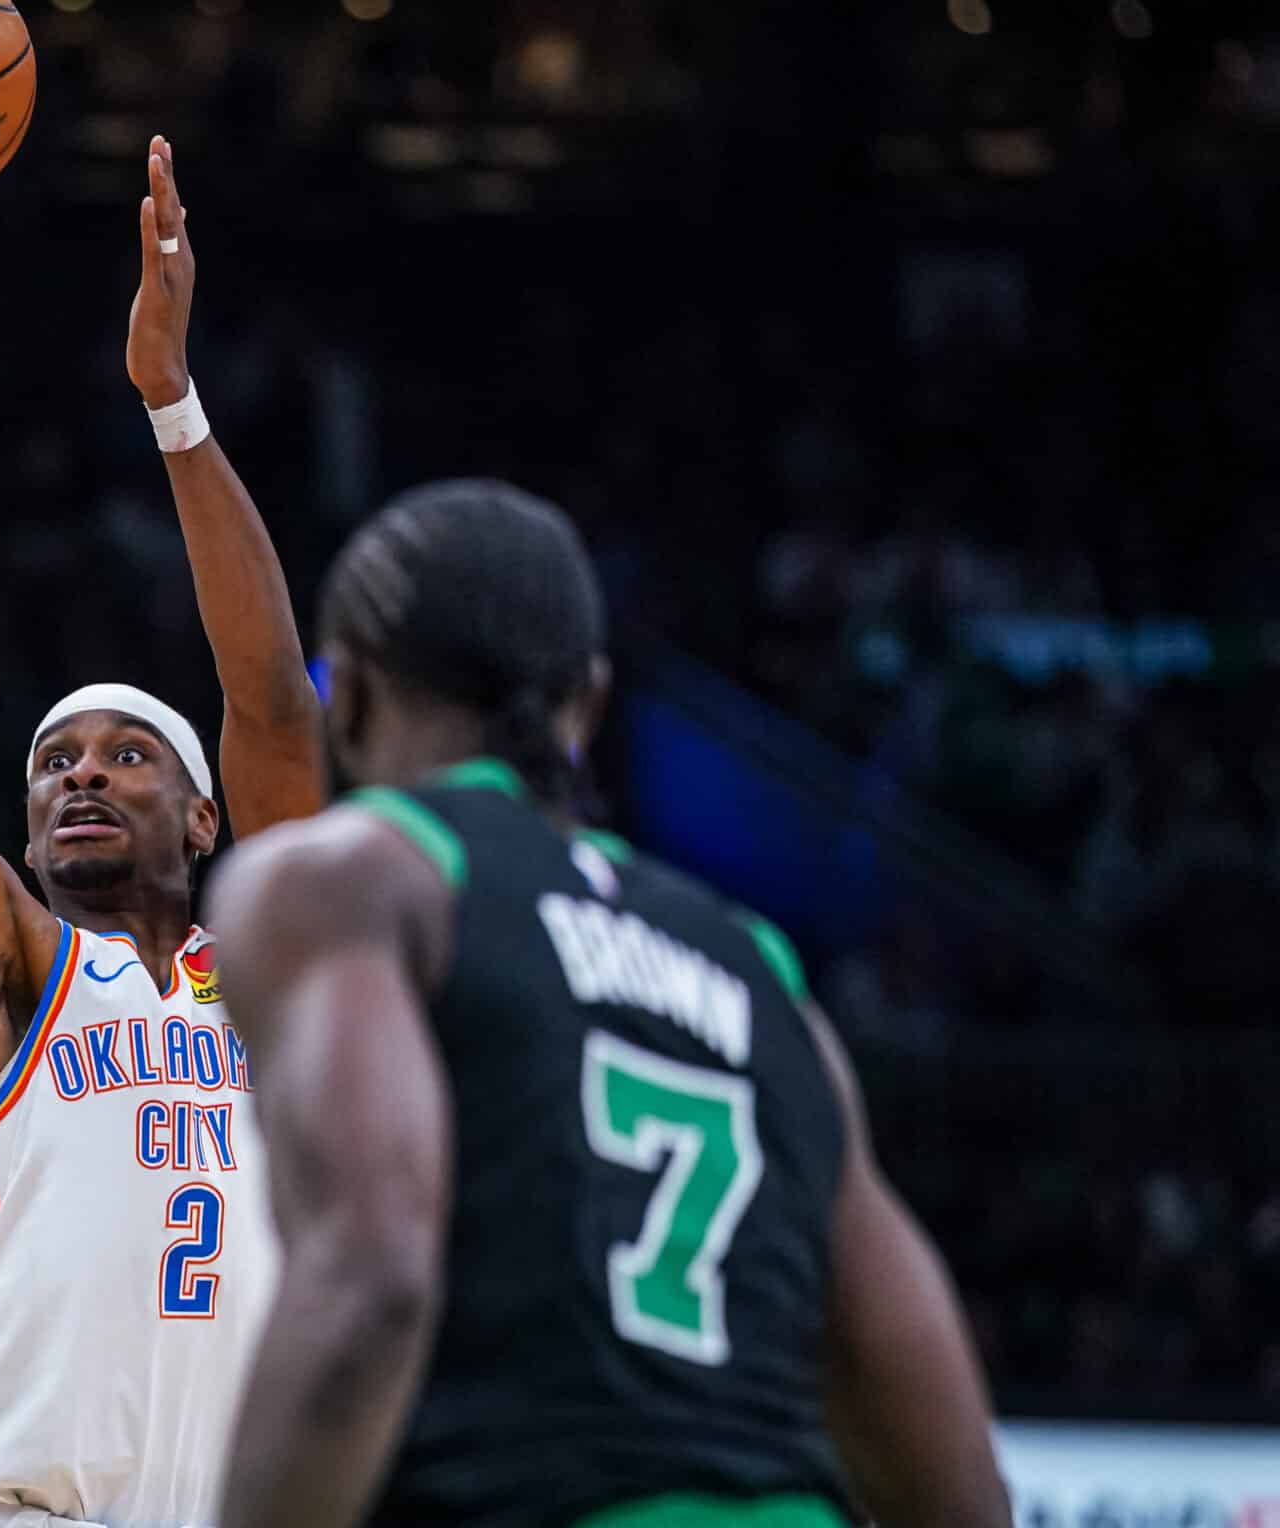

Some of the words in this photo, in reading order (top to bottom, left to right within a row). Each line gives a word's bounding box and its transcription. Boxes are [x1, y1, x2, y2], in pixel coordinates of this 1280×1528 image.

[536, 892, 752, 1068] BROWN
[46, 1016, 255, 1101] OKLAOM
[136, 1099, 237, 1171] CITY
[581, 1027, 763, 1366] 7
[159, 1182, 225, 1320] 2
